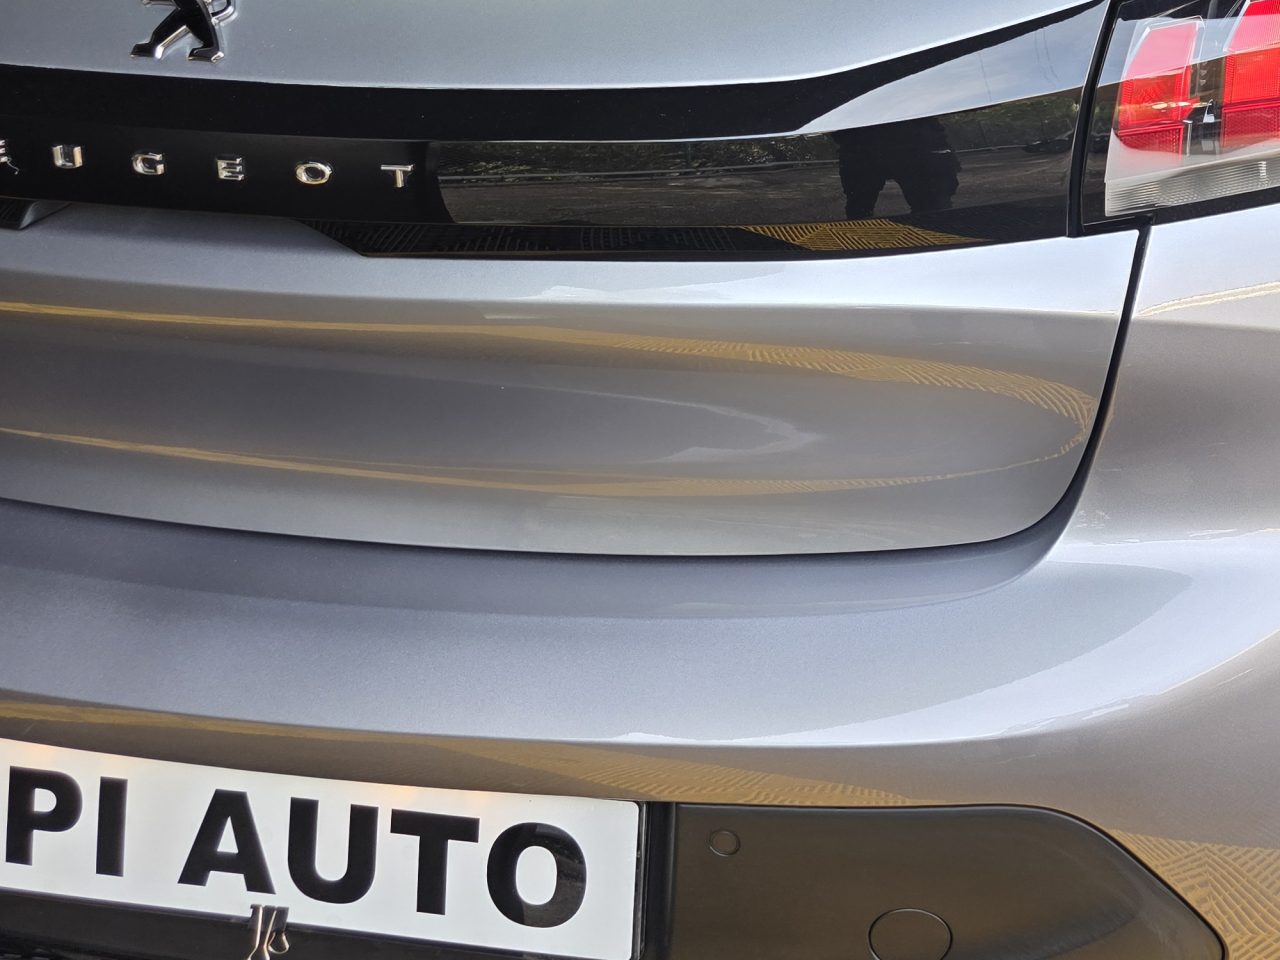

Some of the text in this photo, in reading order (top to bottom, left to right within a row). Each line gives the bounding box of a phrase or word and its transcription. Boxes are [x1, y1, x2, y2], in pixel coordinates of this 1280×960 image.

[0, 139, 414, 188] UGEOT
[4, 765, 588, 929] PI AUTO
